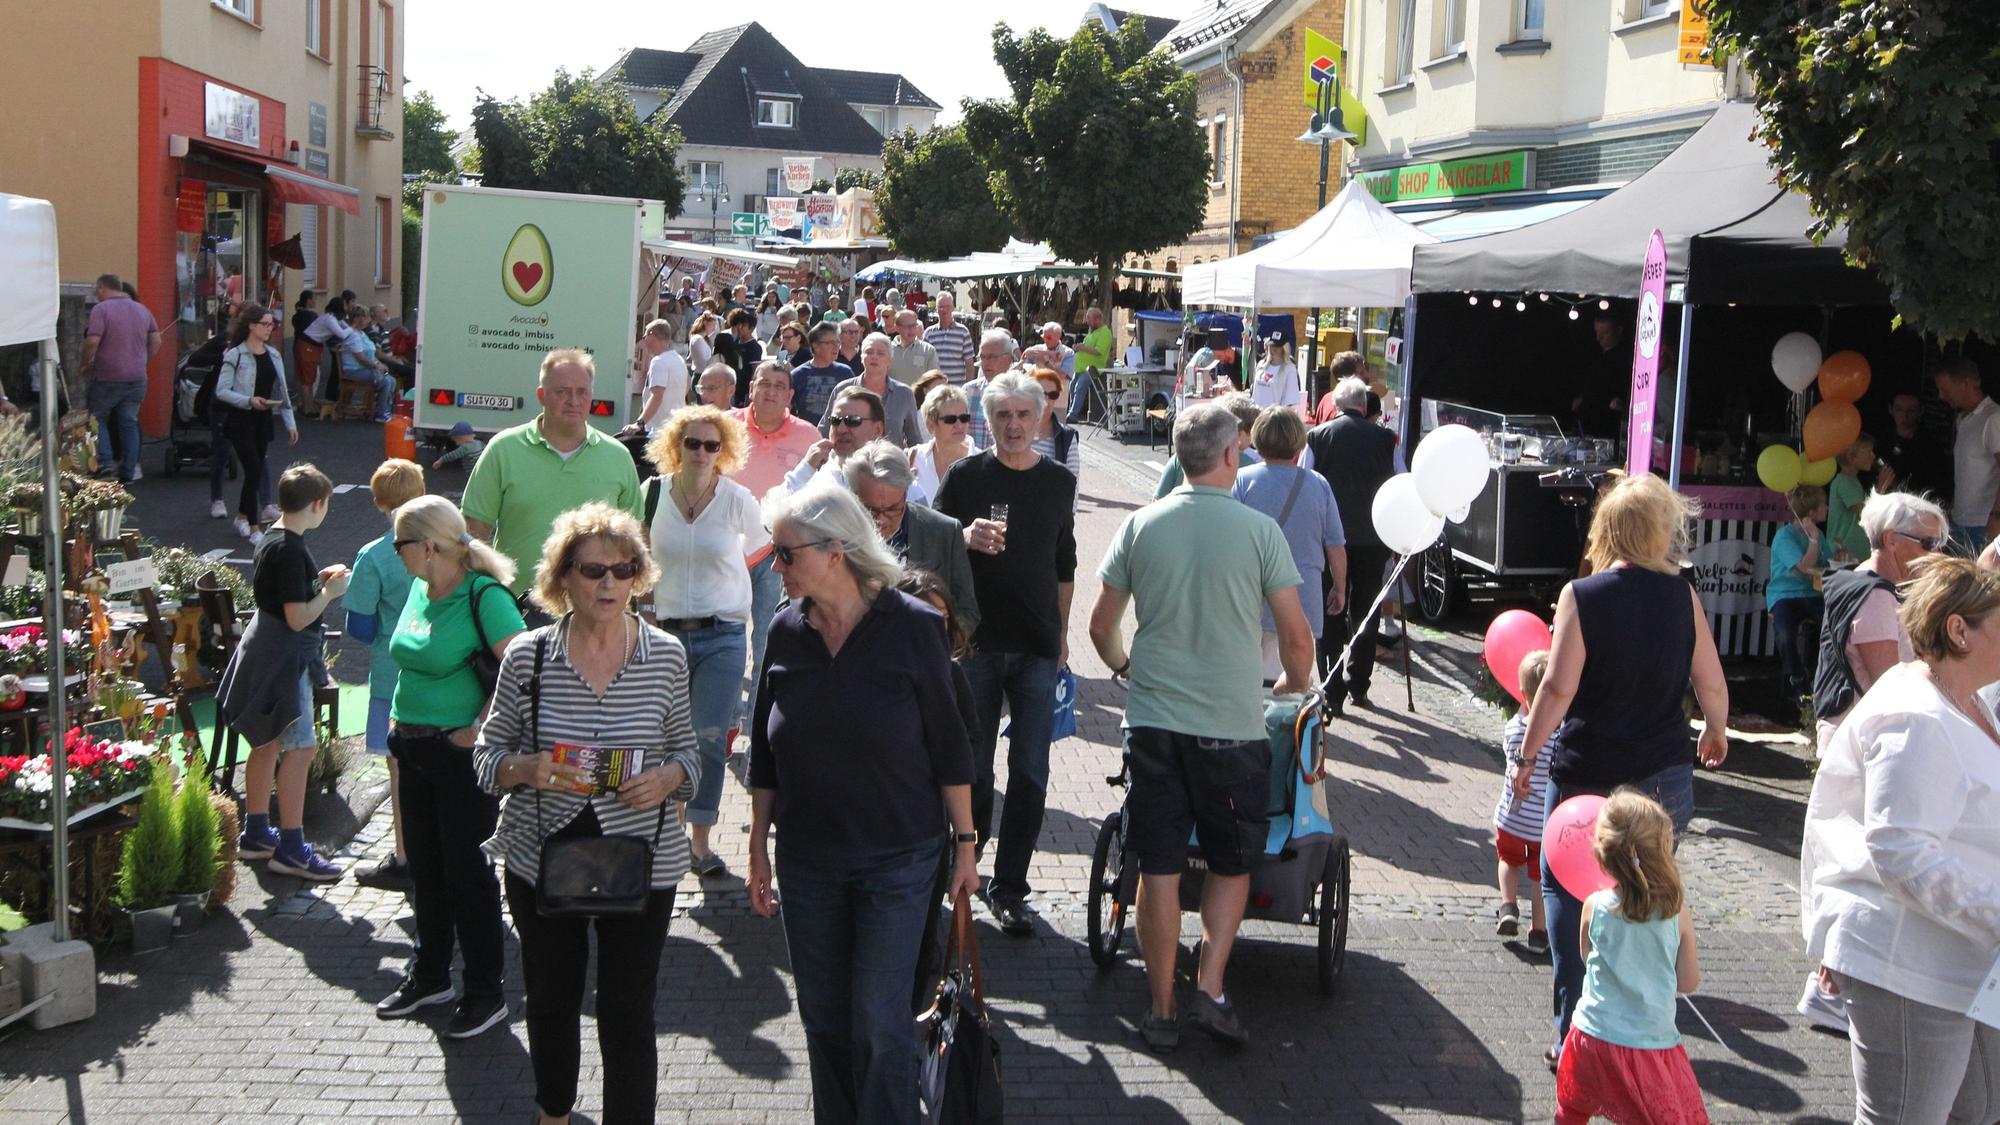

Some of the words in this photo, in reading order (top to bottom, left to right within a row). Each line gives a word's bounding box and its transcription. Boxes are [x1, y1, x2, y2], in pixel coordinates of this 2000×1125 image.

[1398, 172, 1429, 195] SHOP
[1437, 160, 1511, 191] HANGELAR
[466, 396, 478, 405] SU
[497, 398, 509, 407] 30
[112, 569, 127, 578] Bin
[115, 578, 143, 588] Garten
